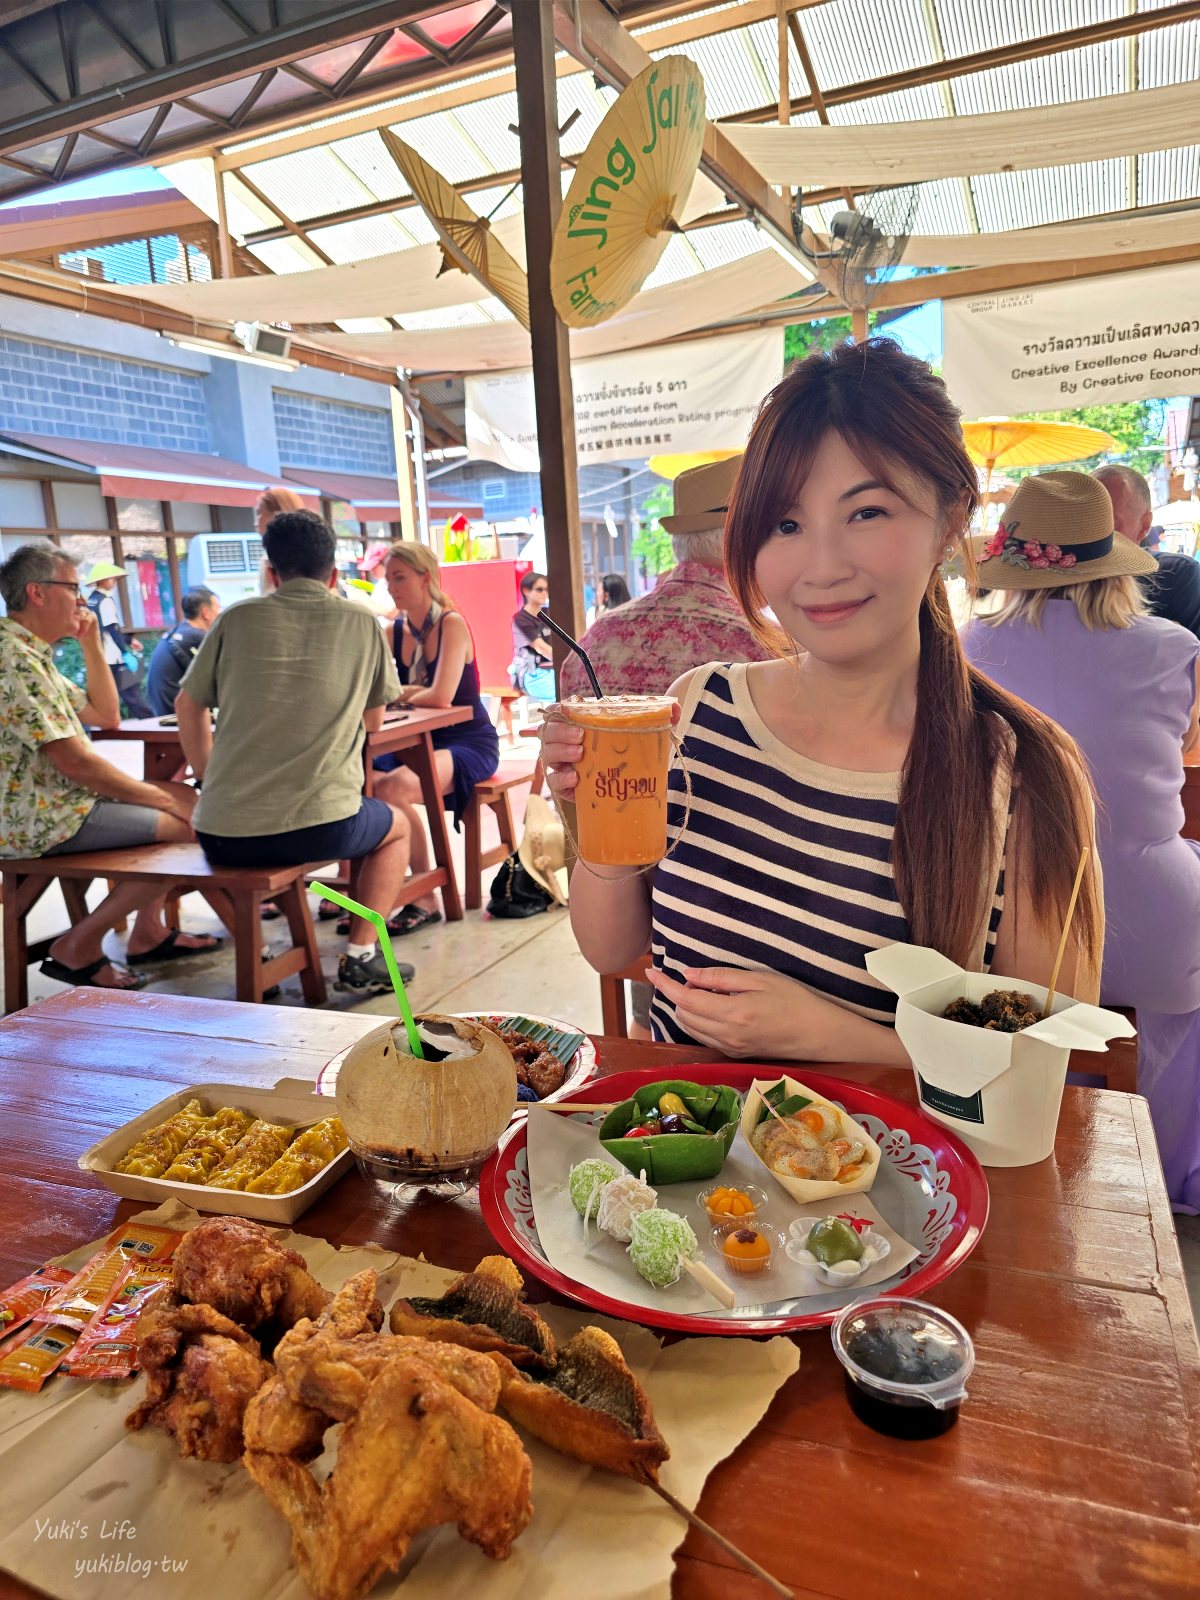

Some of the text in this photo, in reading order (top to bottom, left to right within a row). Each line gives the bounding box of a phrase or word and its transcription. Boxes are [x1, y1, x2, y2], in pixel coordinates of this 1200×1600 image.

[567, 69, 680, 250] Jing Jai
[1011, 363, 1070, 380] Creative
[1075, 353, 1147, 372] Excellence
[1060, 380, 1077, 393] By
[1083, 373, 1144, 390] Creative
[593, 405, 650, 418] certificate
[653, 401, 678, 412] from
